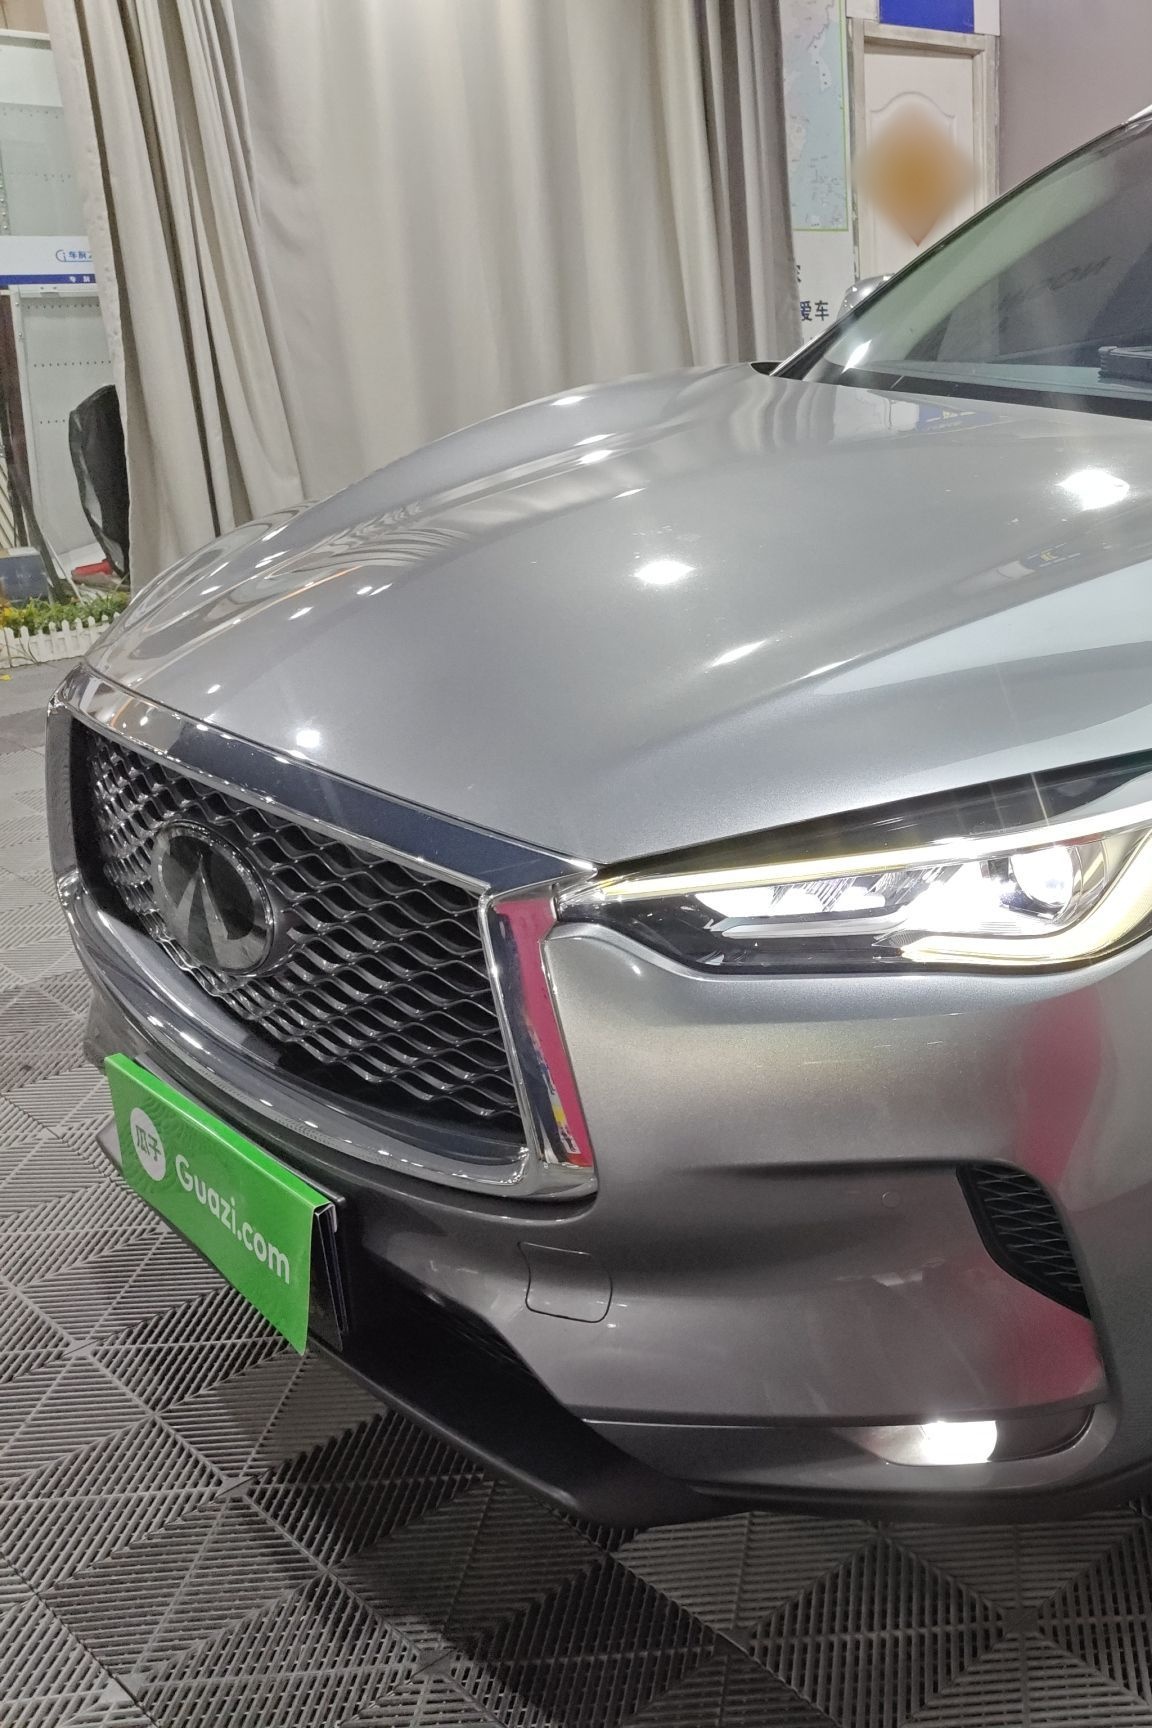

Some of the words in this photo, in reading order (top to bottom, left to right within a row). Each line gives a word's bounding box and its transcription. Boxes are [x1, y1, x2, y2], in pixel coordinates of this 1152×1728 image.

[799, 300, 829, 321] 爱车
[134, 1124, 162, 1162] 瓜子
[174, 1153, 290, 1285] Guazi.com
